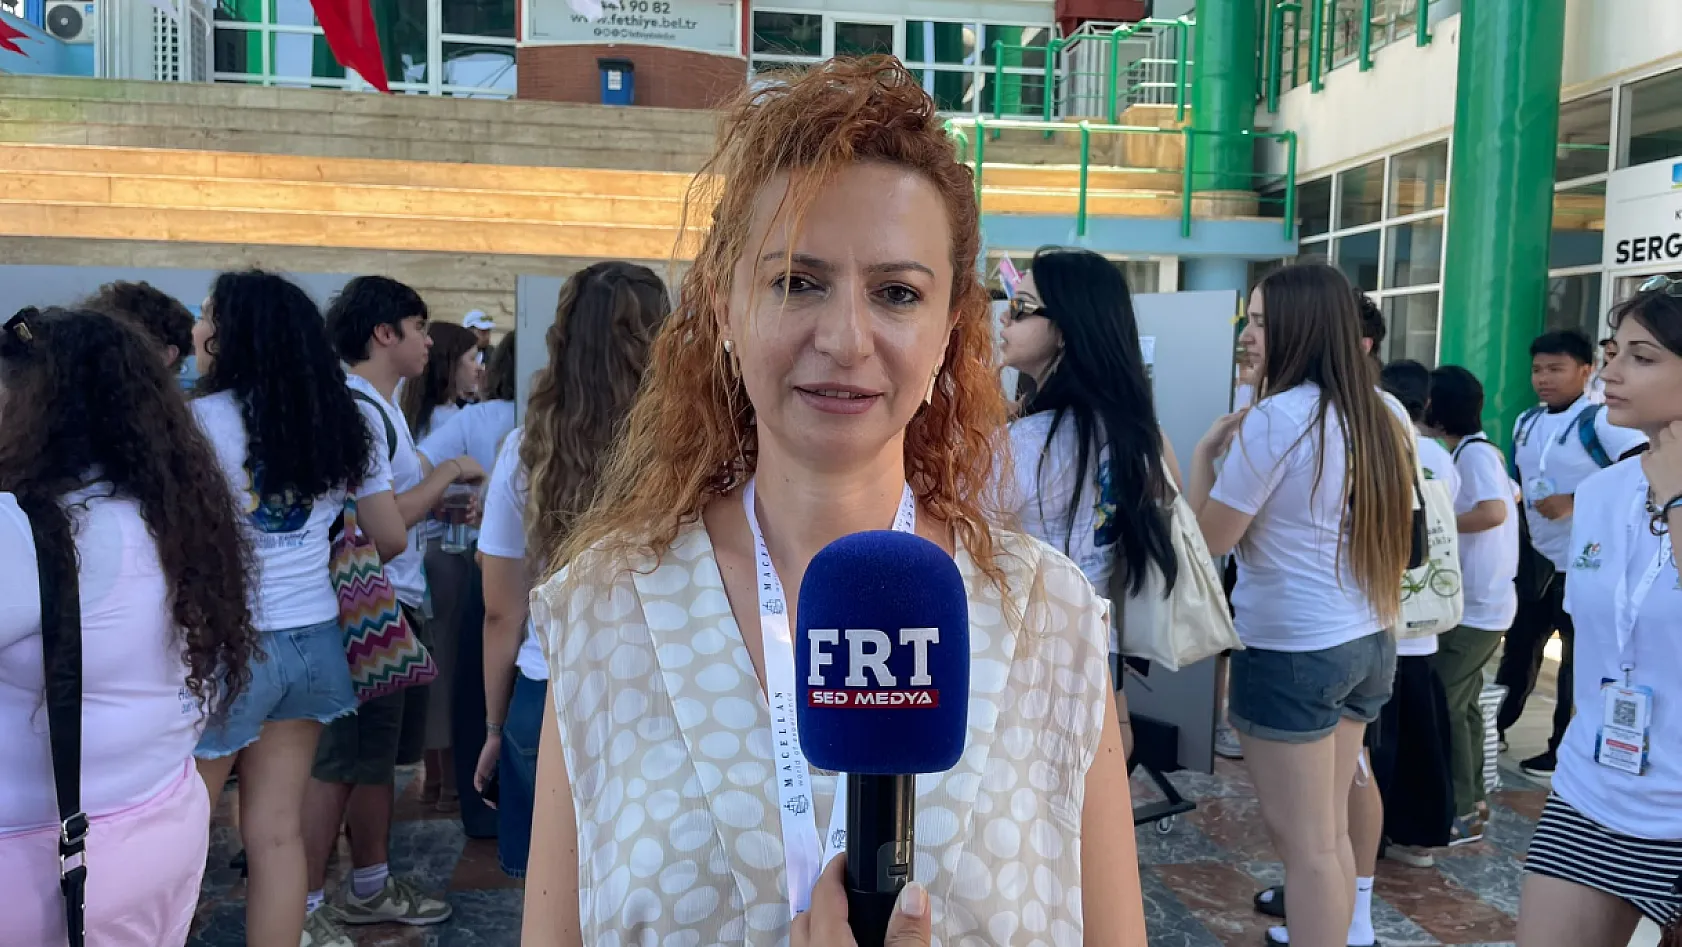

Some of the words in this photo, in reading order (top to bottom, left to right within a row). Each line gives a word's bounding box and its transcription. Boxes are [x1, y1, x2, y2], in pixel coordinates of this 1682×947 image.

[629, 0, 648, 12] 90
[652, 3, 671, 14] 82
[570, 14, 697, 29] ww.fethiye.bel.tr
[1615, 232, 1682, 264] SERG
[807, 628, 939, 687] FRT
[812, 691, 849, 705] SED
[854, 691, 932, 705] MEDYA
[794, 760, 803, 786] world
